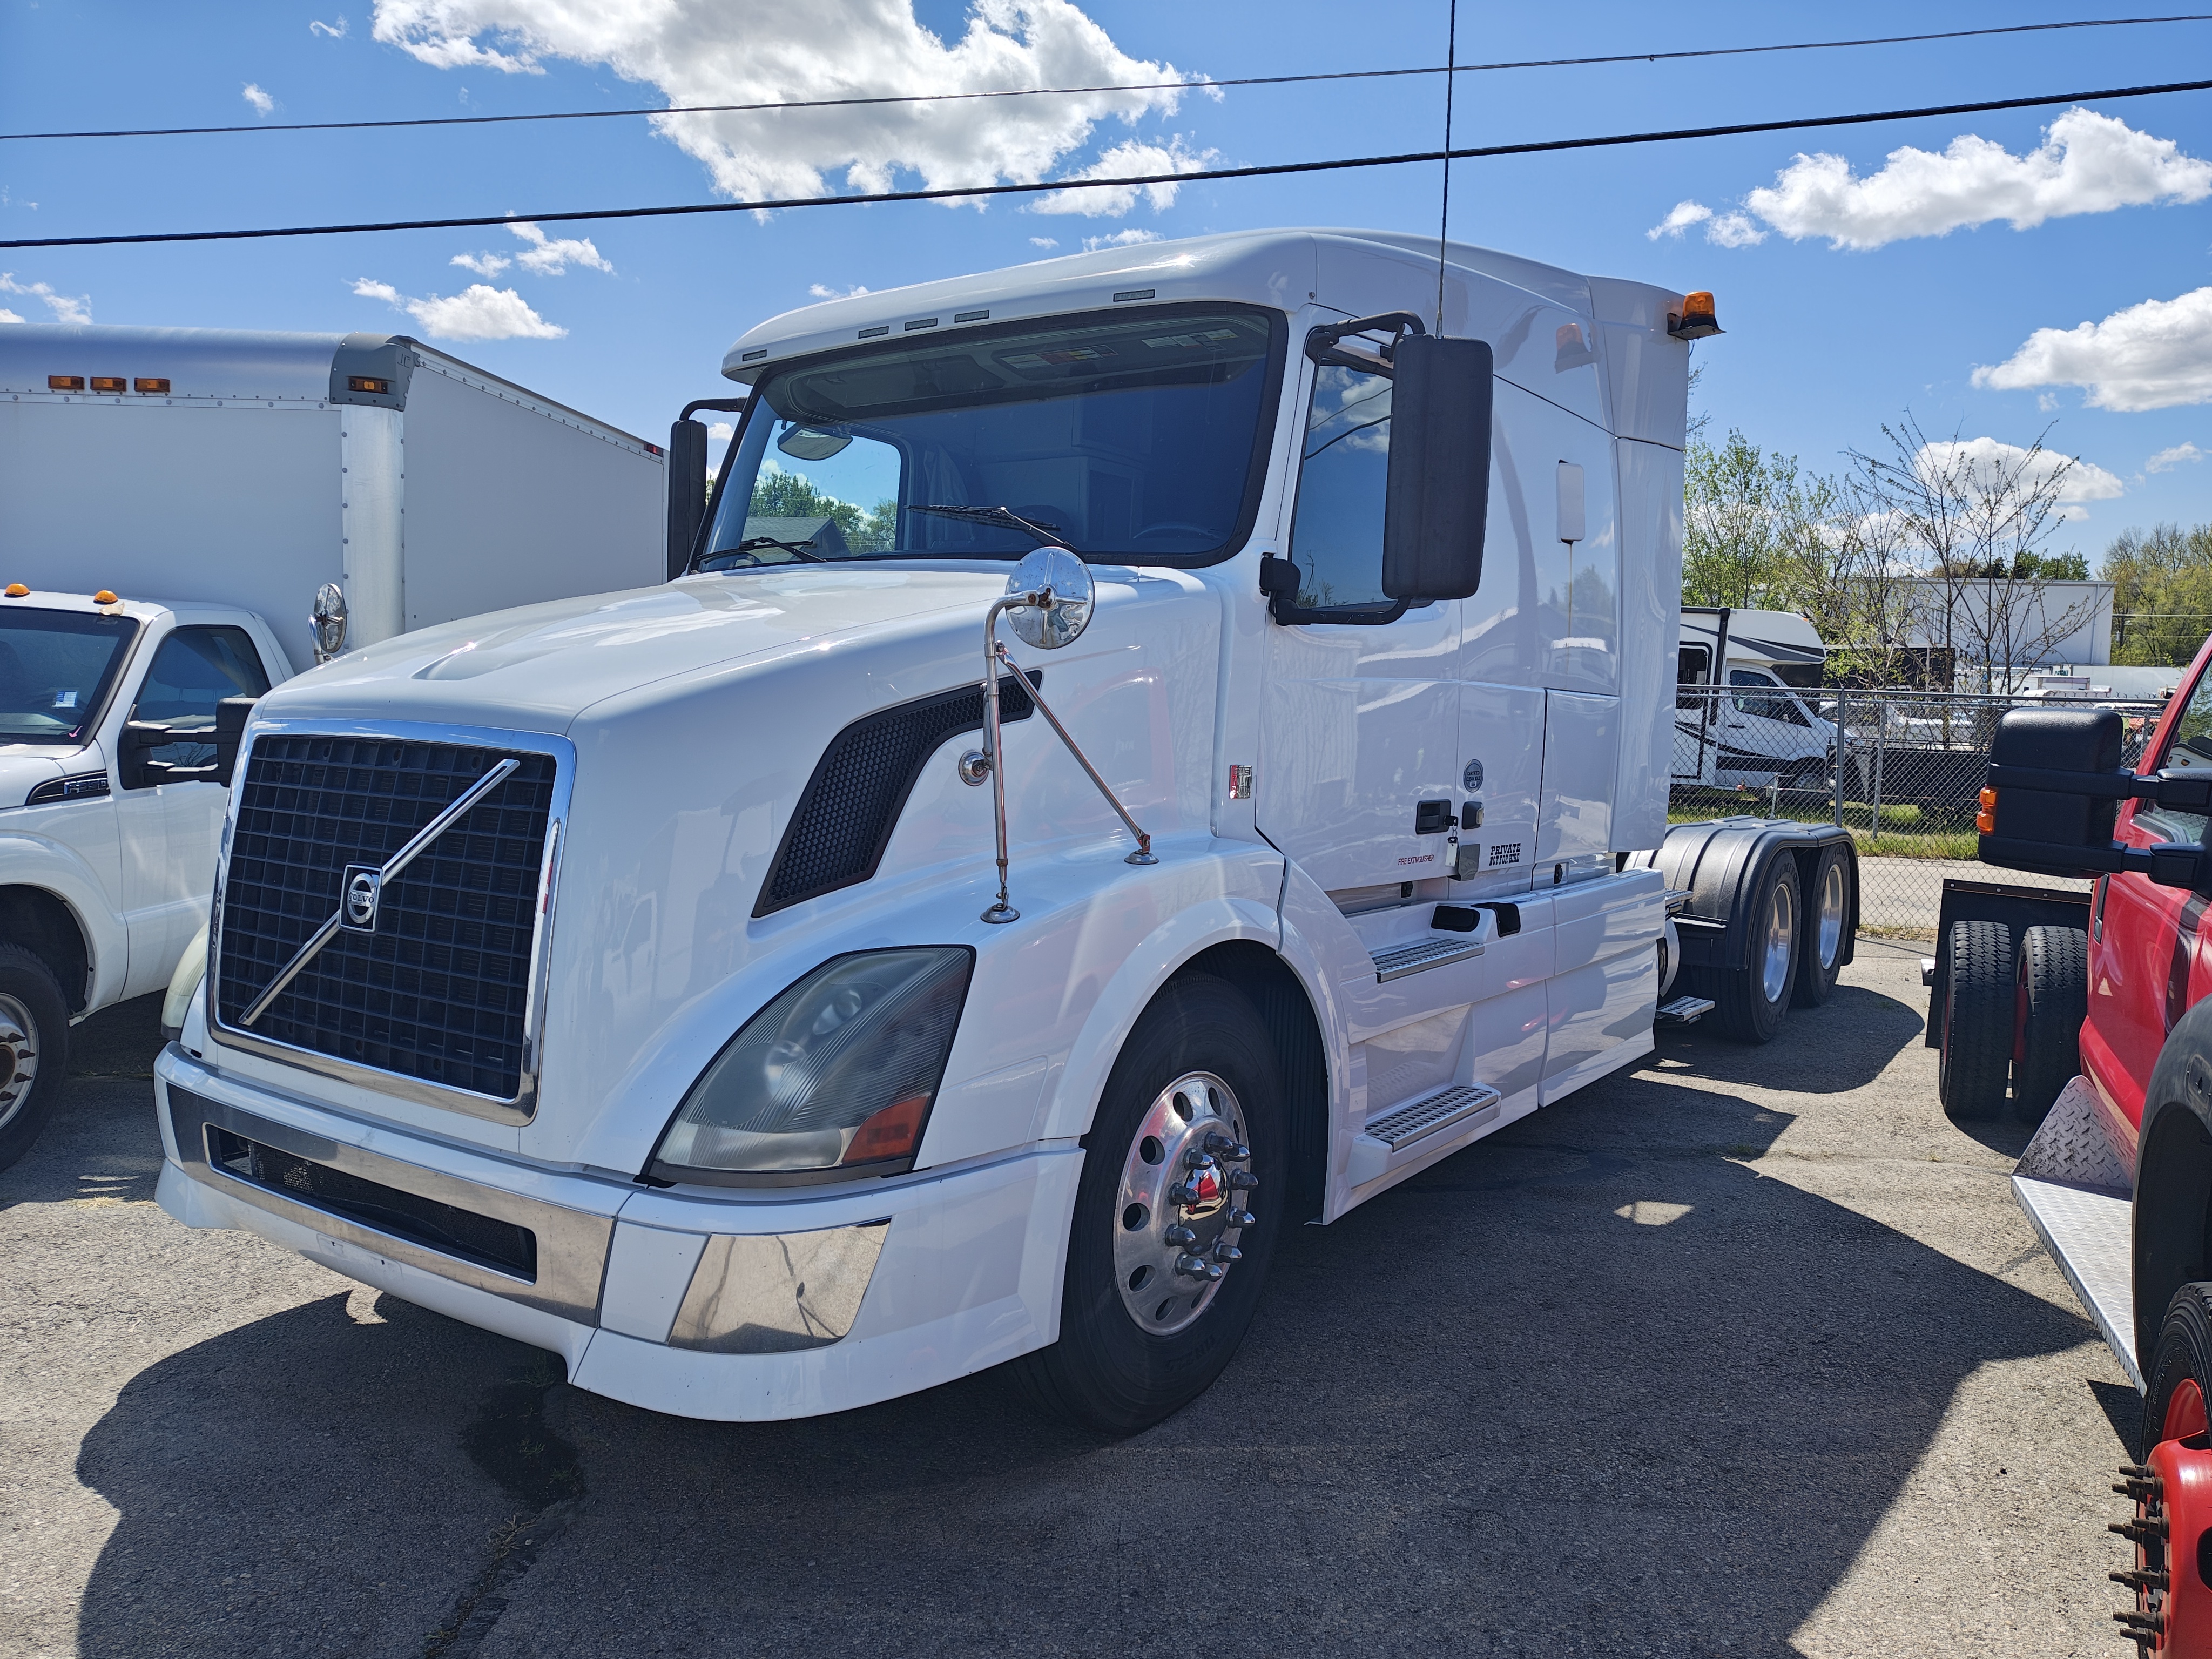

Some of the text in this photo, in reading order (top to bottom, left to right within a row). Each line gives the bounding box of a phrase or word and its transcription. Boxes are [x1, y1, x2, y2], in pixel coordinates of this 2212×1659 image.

[1491, 843, 1521, 855] PRIVATE
[1398, 854, 1434, 865] FIRE EXTINGUISHER
[1489, 853, 1520, 866] NOT FOR HIRE
[348, 892, 375, 903] VOLVO
